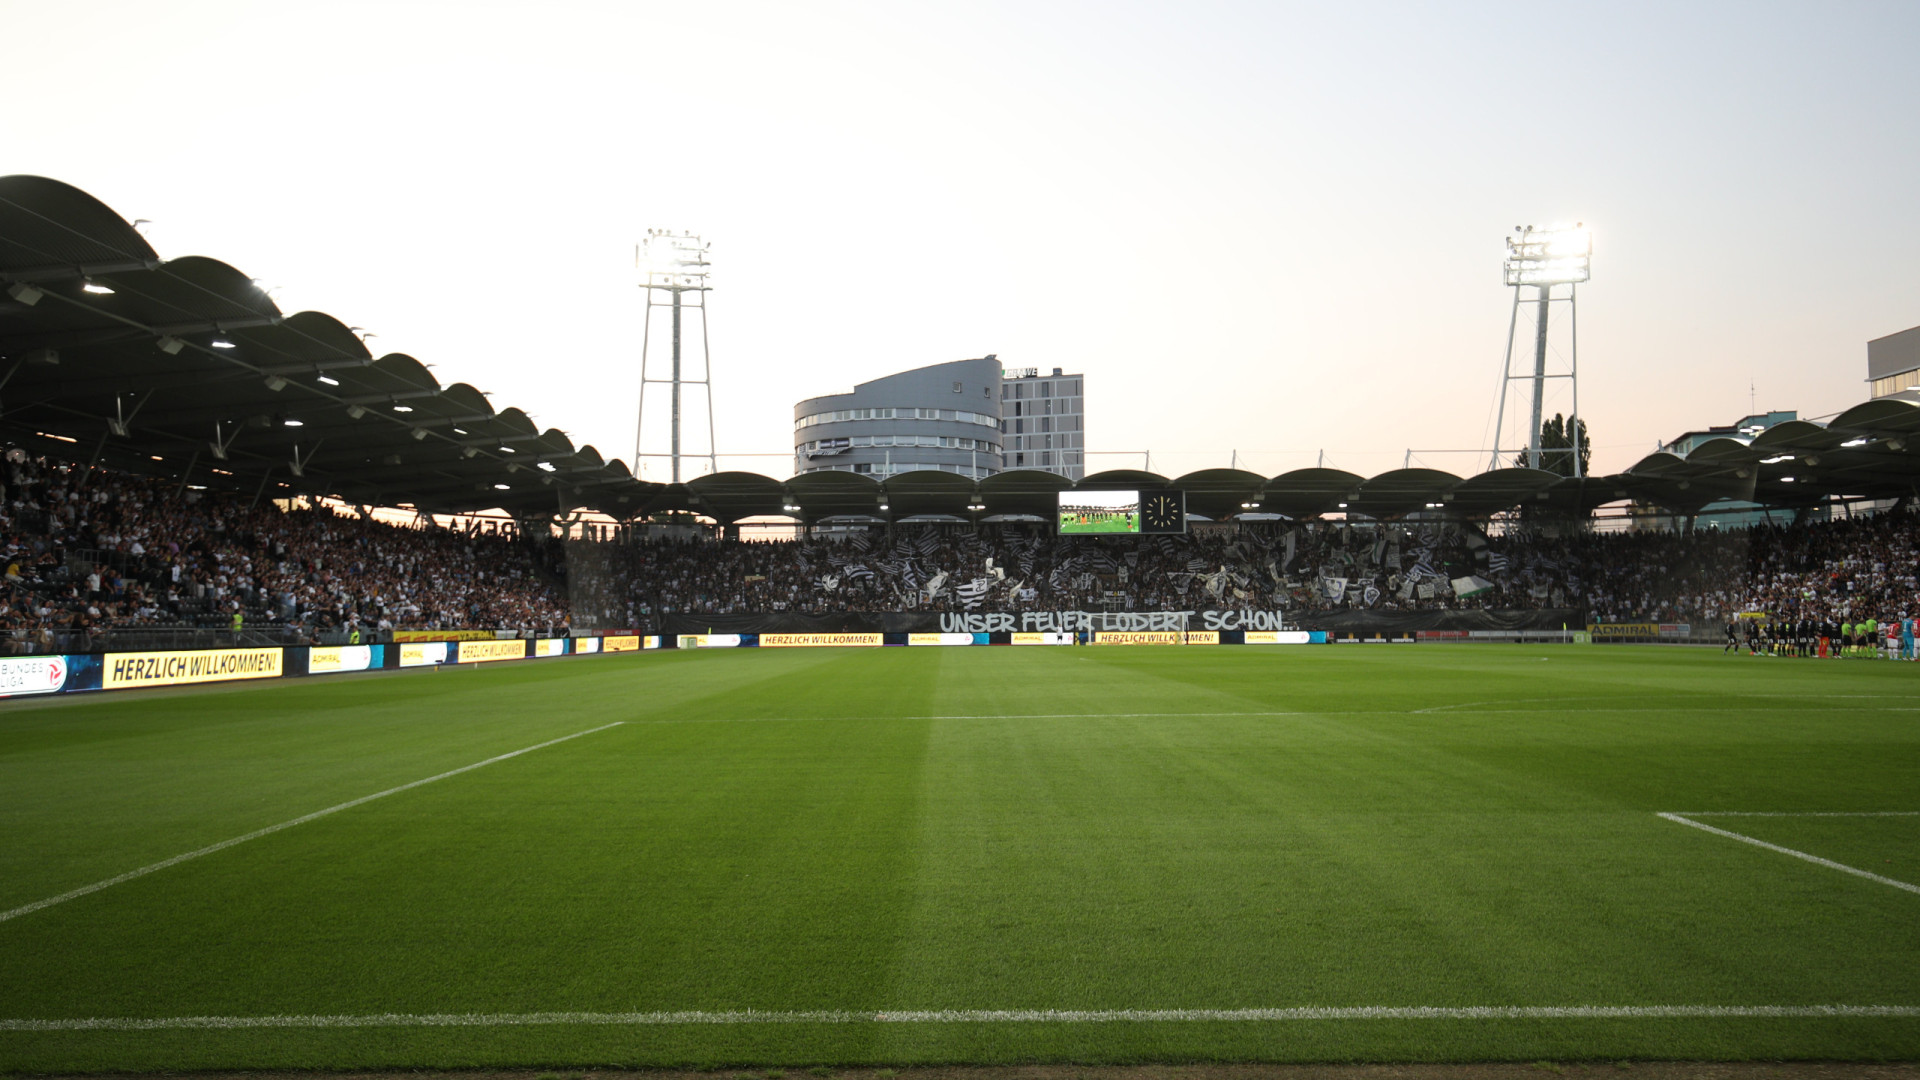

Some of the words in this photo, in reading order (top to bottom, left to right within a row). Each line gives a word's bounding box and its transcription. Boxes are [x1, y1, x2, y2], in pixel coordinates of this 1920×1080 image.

[940, 611, 1018, 633] UNSER
[1021, 610, 1096, 633] FEUER
[1102, 610, 1196, 632] LODERT
[1592, 624, 1655, 635] ADMIRAL
[765, 635, 809, 645] HERZLICH
[812, 635, 878, 644] WILLKOMMEN!
[1101, 633, 1146, 643] HERZLICH
[1, 662, 44, 675] BUNDES
[113, 656, 187, 681] HERZLICH
[190, 652, 277, 676] WILLKOMMEN!
[0, 677, 24, 688] LIGA
